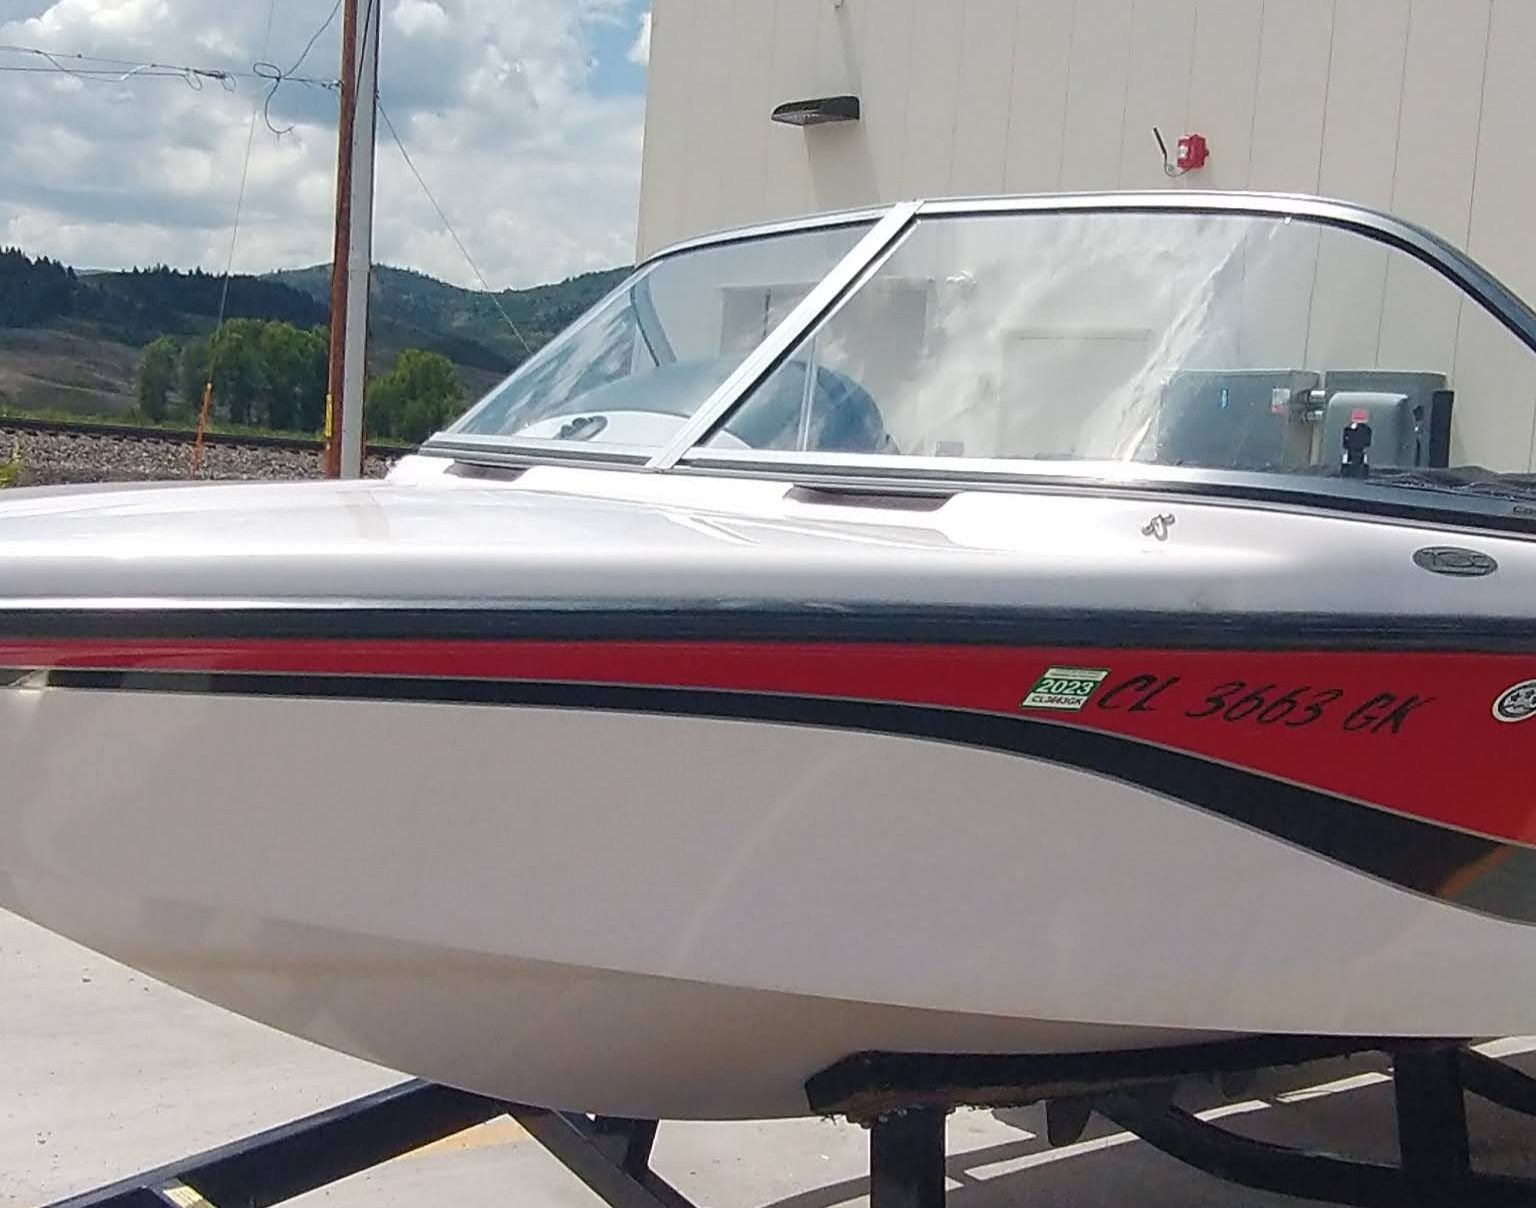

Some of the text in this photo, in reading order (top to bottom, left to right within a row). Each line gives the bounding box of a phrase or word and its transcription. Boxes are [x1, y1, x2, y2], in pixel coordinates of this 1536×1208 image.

[1035, 679, 1094, 695] 2023
[1097, 673, 1437, 734] CL 3663 GK
